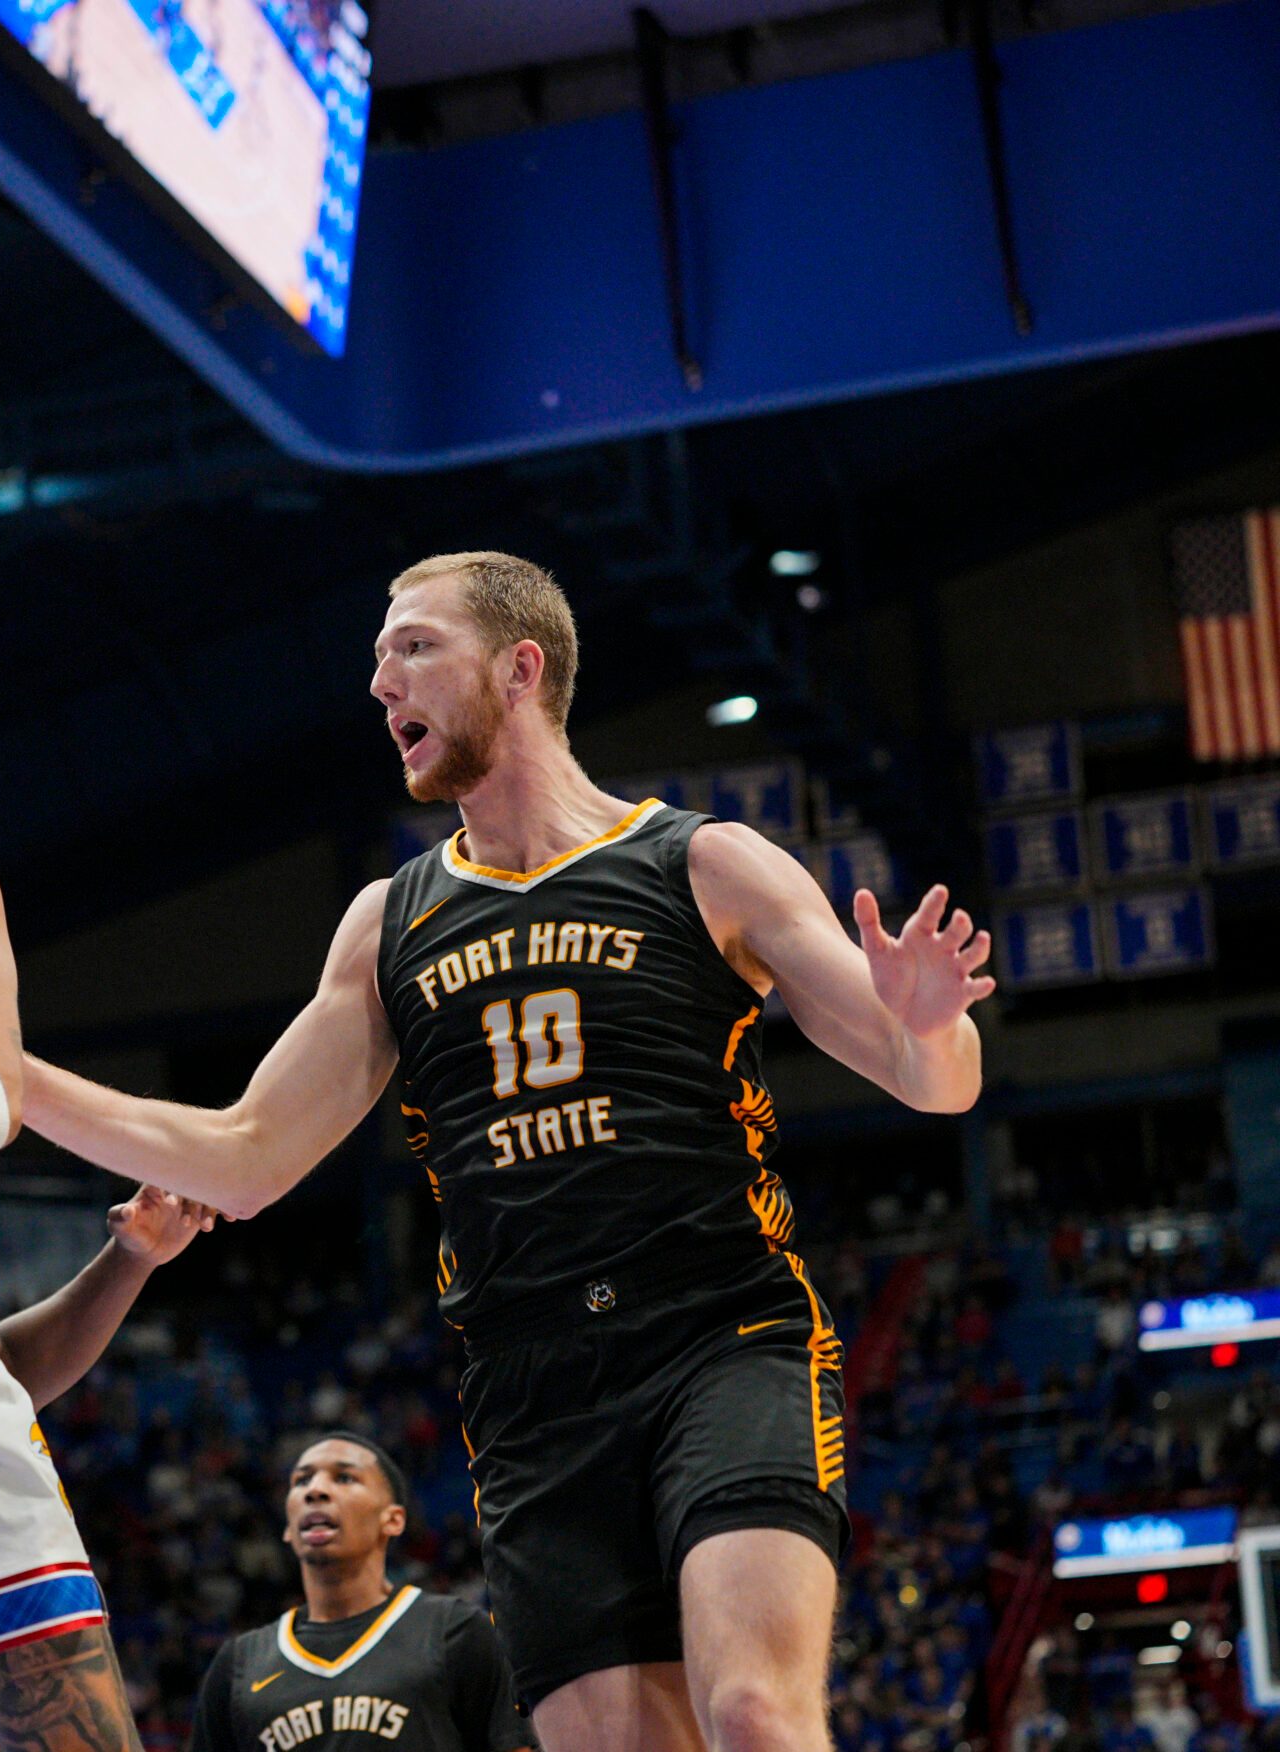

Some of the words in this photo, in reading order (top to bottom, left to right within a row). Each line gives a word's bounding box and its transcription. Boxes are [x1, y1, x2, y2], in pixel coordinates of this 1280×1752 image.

[415, 928, 515, 1010] FORT
[528, 922, 645, 971] HAYS
[481, 987, 586, 1099] 10
[487, 1096, 618, 1168] STATE
[258, 1700, 323, 1752] FORT
[332, 1696, 409, 1740] HAYS
